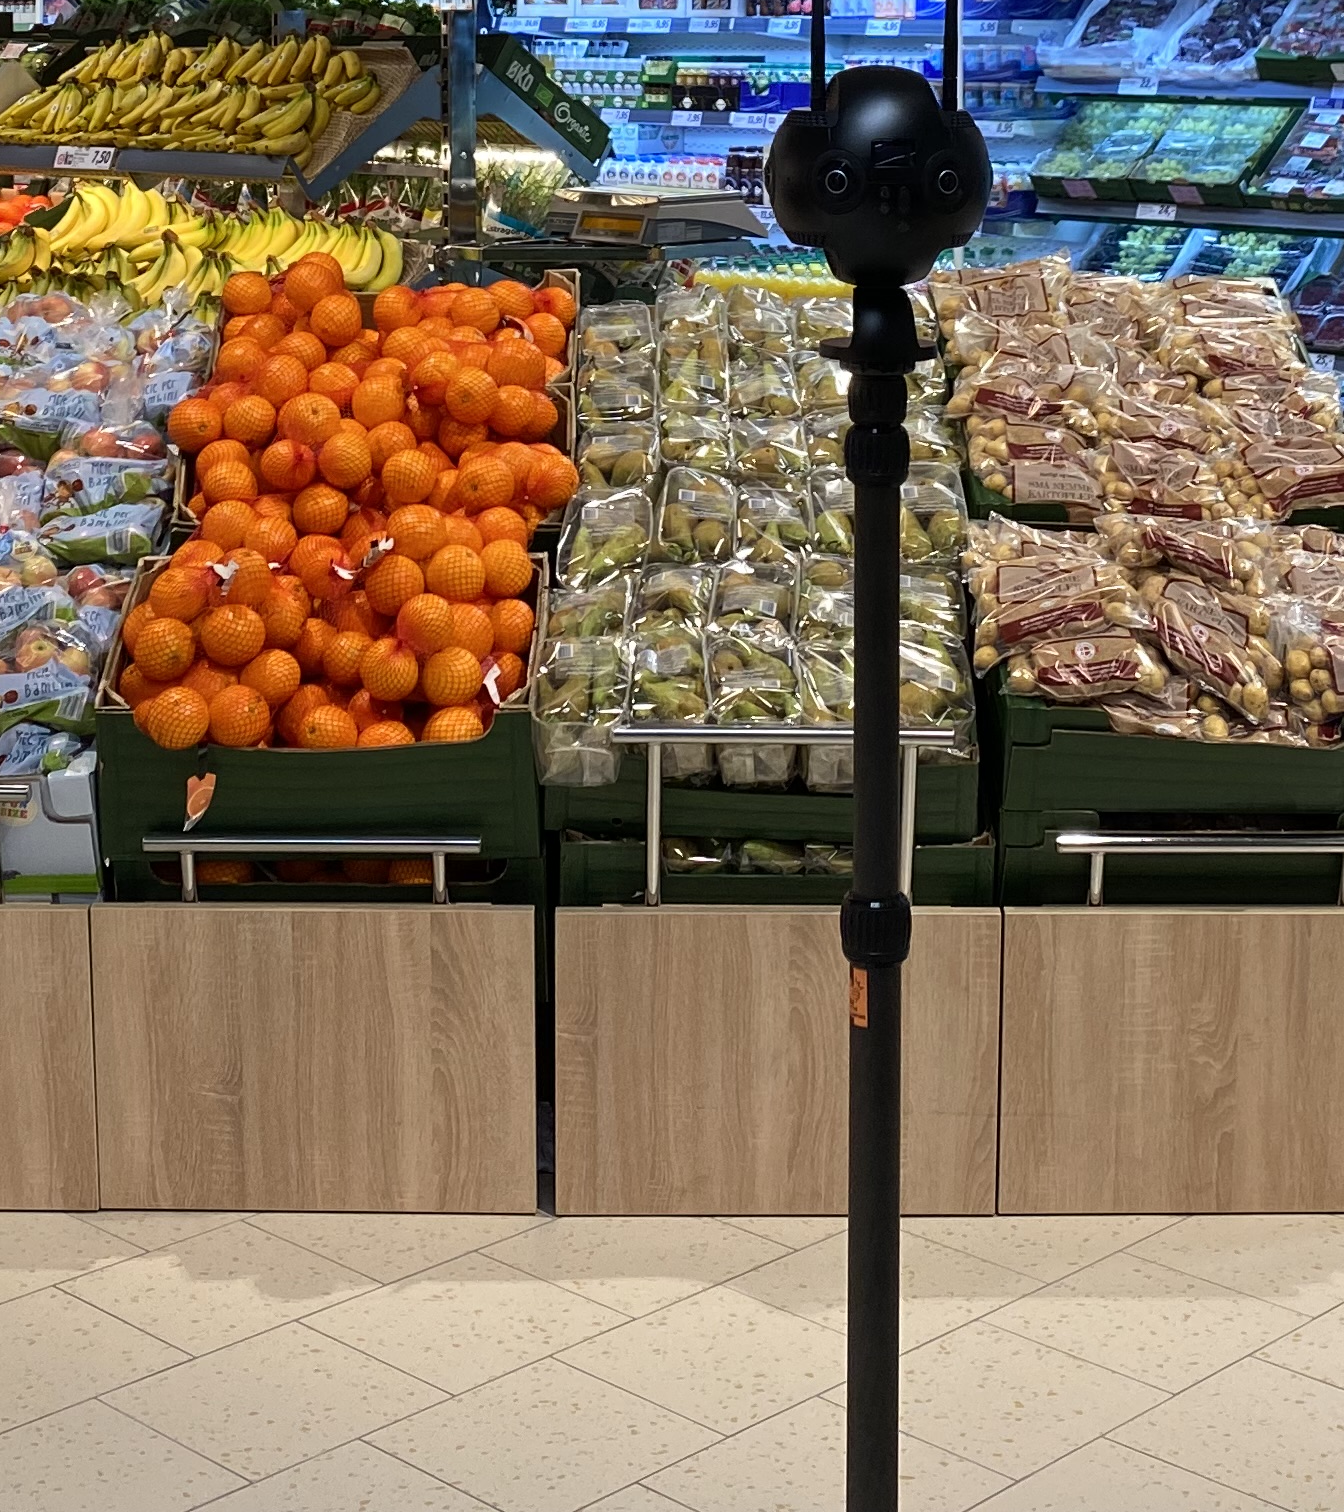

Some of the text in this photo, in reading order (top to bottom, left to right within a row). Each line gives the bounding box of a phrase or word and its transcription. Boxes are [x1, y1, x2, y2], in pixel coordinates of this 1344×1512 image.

[506, 60, 591, 143] ØKO Organic
[92, 150, 111, 165] 7,50
